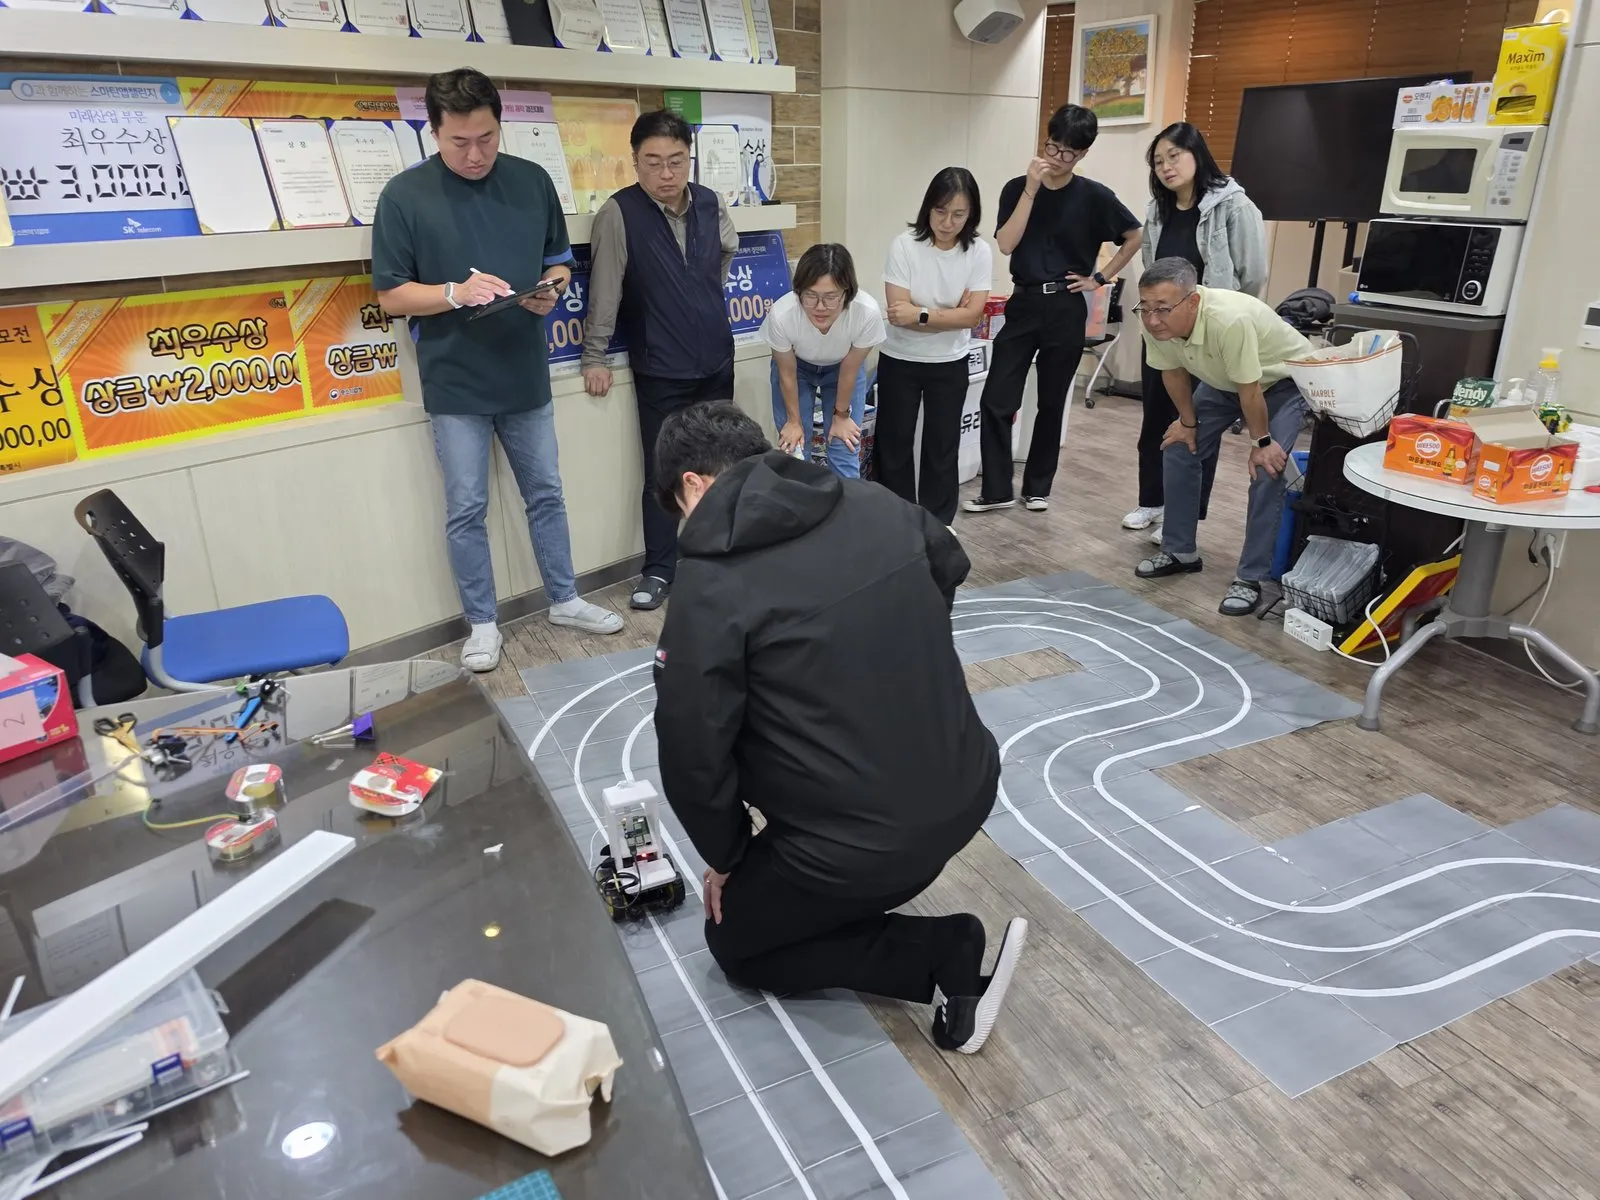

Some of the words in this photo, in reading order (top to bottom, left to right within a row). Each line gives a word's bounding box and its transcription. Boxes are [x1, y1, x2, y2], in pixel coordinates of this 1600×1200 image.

[1506, 49, 1545, 64] Maxim
[69, 109, 118, 123] 미래산업
[122, 110, 148, 123] 부문
[62, 127, 167, 155] 최우수상
[123, 226, 135, 234] SK
[148, 317, 268, 359] 최우수상
[1310, 389, 1336, 398] MARBLE
